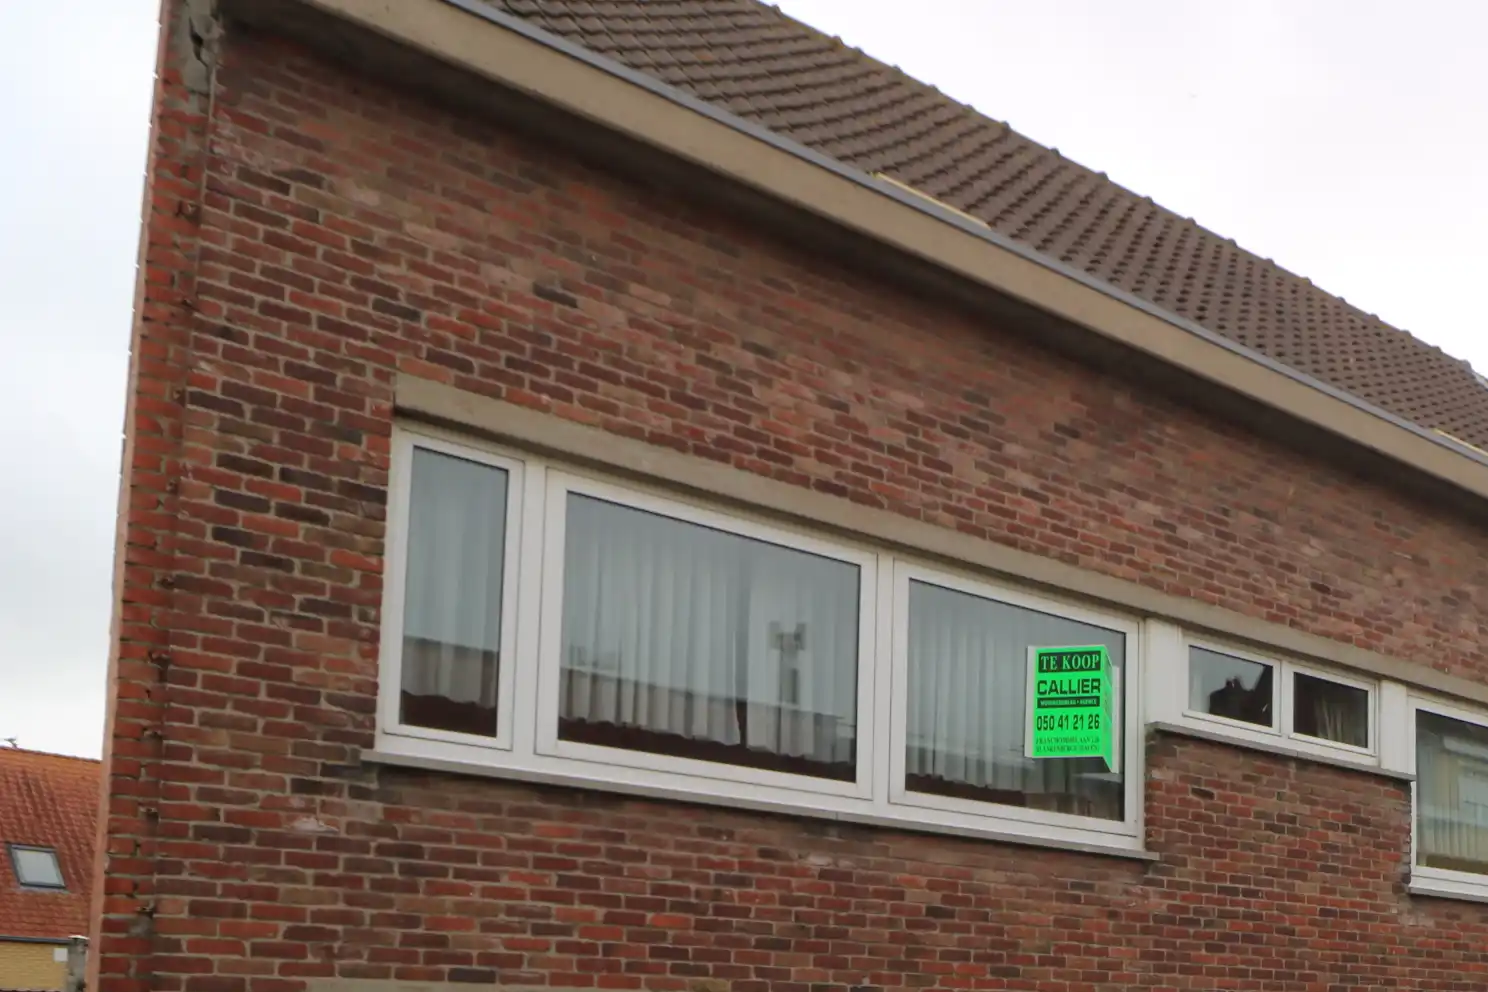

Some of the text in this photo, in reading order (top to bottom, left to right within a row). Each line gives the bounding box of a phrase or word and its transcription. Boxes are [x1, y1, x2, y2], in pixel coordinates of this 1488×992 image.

[1041, 654, 1099, 670] TE KOOP
[1037, 678, 1101, 695] CALLIER
[1036, 713, 1100, 731] 050 41 21 26
